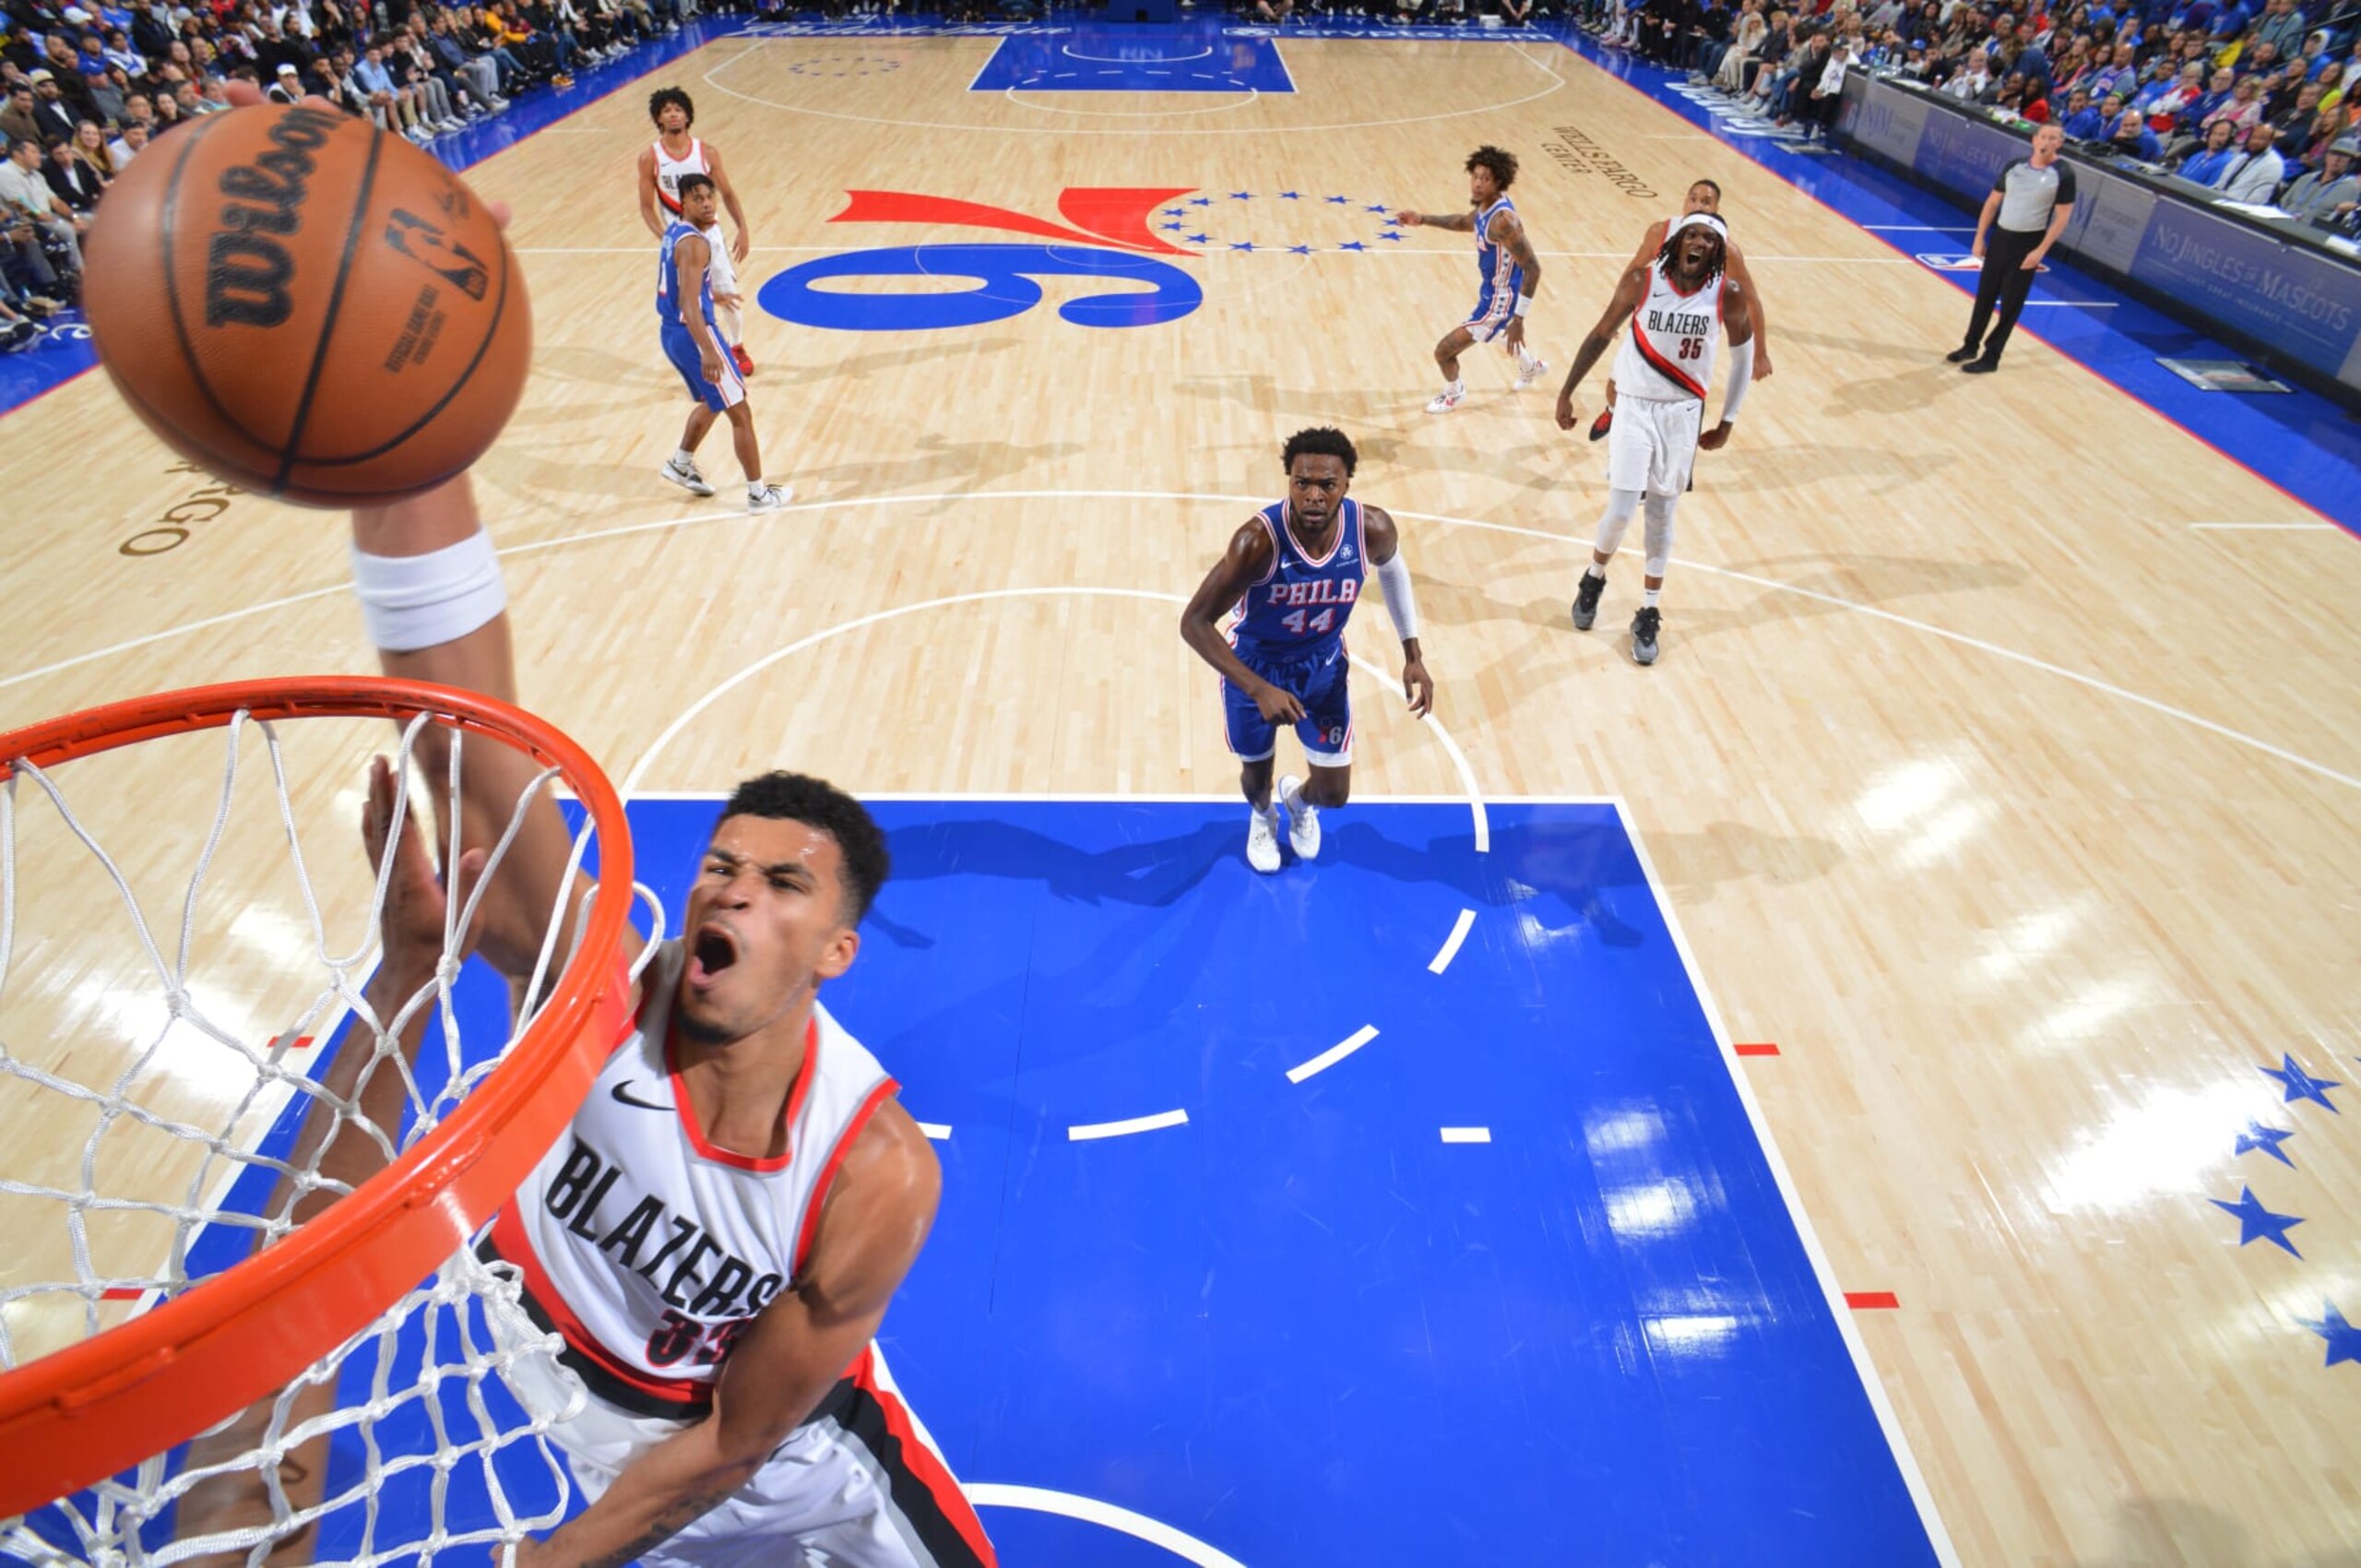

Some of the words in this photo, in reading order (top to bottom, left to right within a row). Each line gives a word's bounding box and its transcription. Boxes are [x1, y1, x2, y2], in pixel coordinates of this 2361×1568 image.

[1296, 30, 1554, 41] crypto.com
[1541, 143, 1592, 173] CENTER
[1552, 125, 1610, 159] WELLS
[1589, 160, 1658, 198] FARGO
[207, 108, 350, 328] Wilson
[2255, 270, 2351, 331] MASCOTS
[1647, 308, 1710, 336] BLAZERS
[1679, 338, 1703, 360] 35
[1267, 578, 1358, 606] PHILA
[1280, 608, 1337, 634] 44
[545, 1127, 783, 1317] BLAZERS
[646, 1309, 753, 1367] 33
